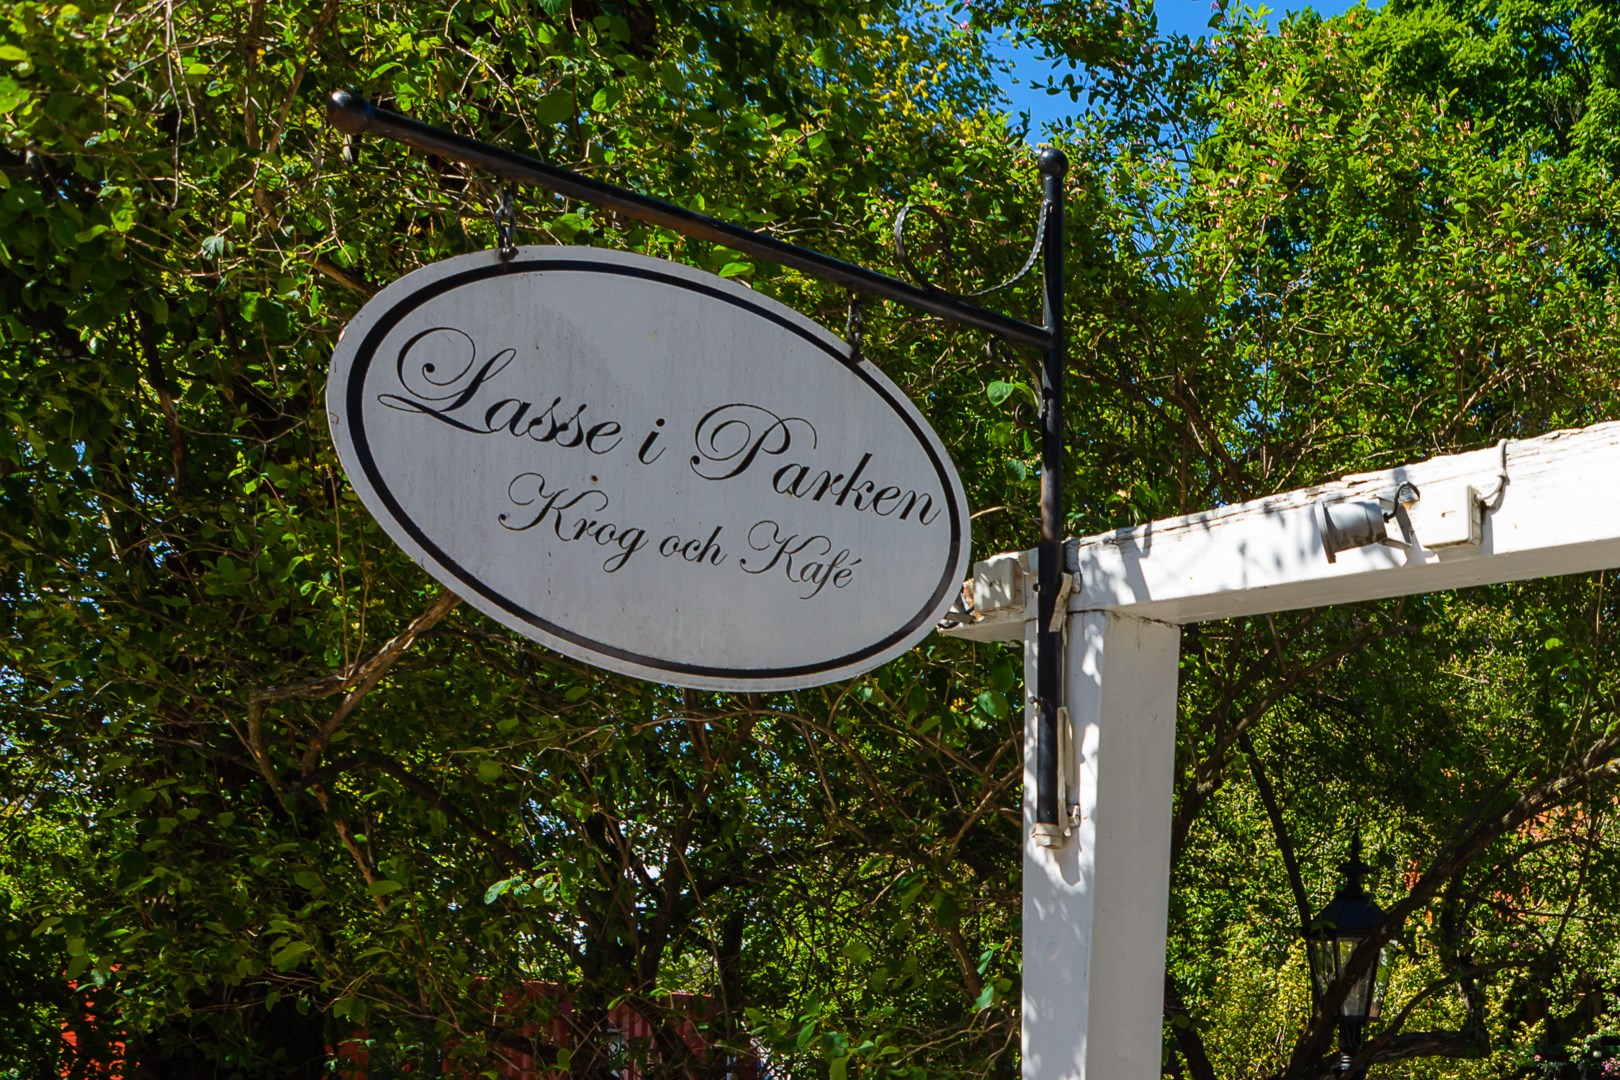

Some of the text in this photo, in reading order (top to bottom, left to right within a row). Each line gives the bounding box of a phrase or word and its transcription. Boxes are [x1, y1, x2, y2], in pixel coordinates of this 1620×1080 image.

[378, 326, 940, 525] Lasse i Parken
[499, 472, 863, 600] Krog och Kafé
